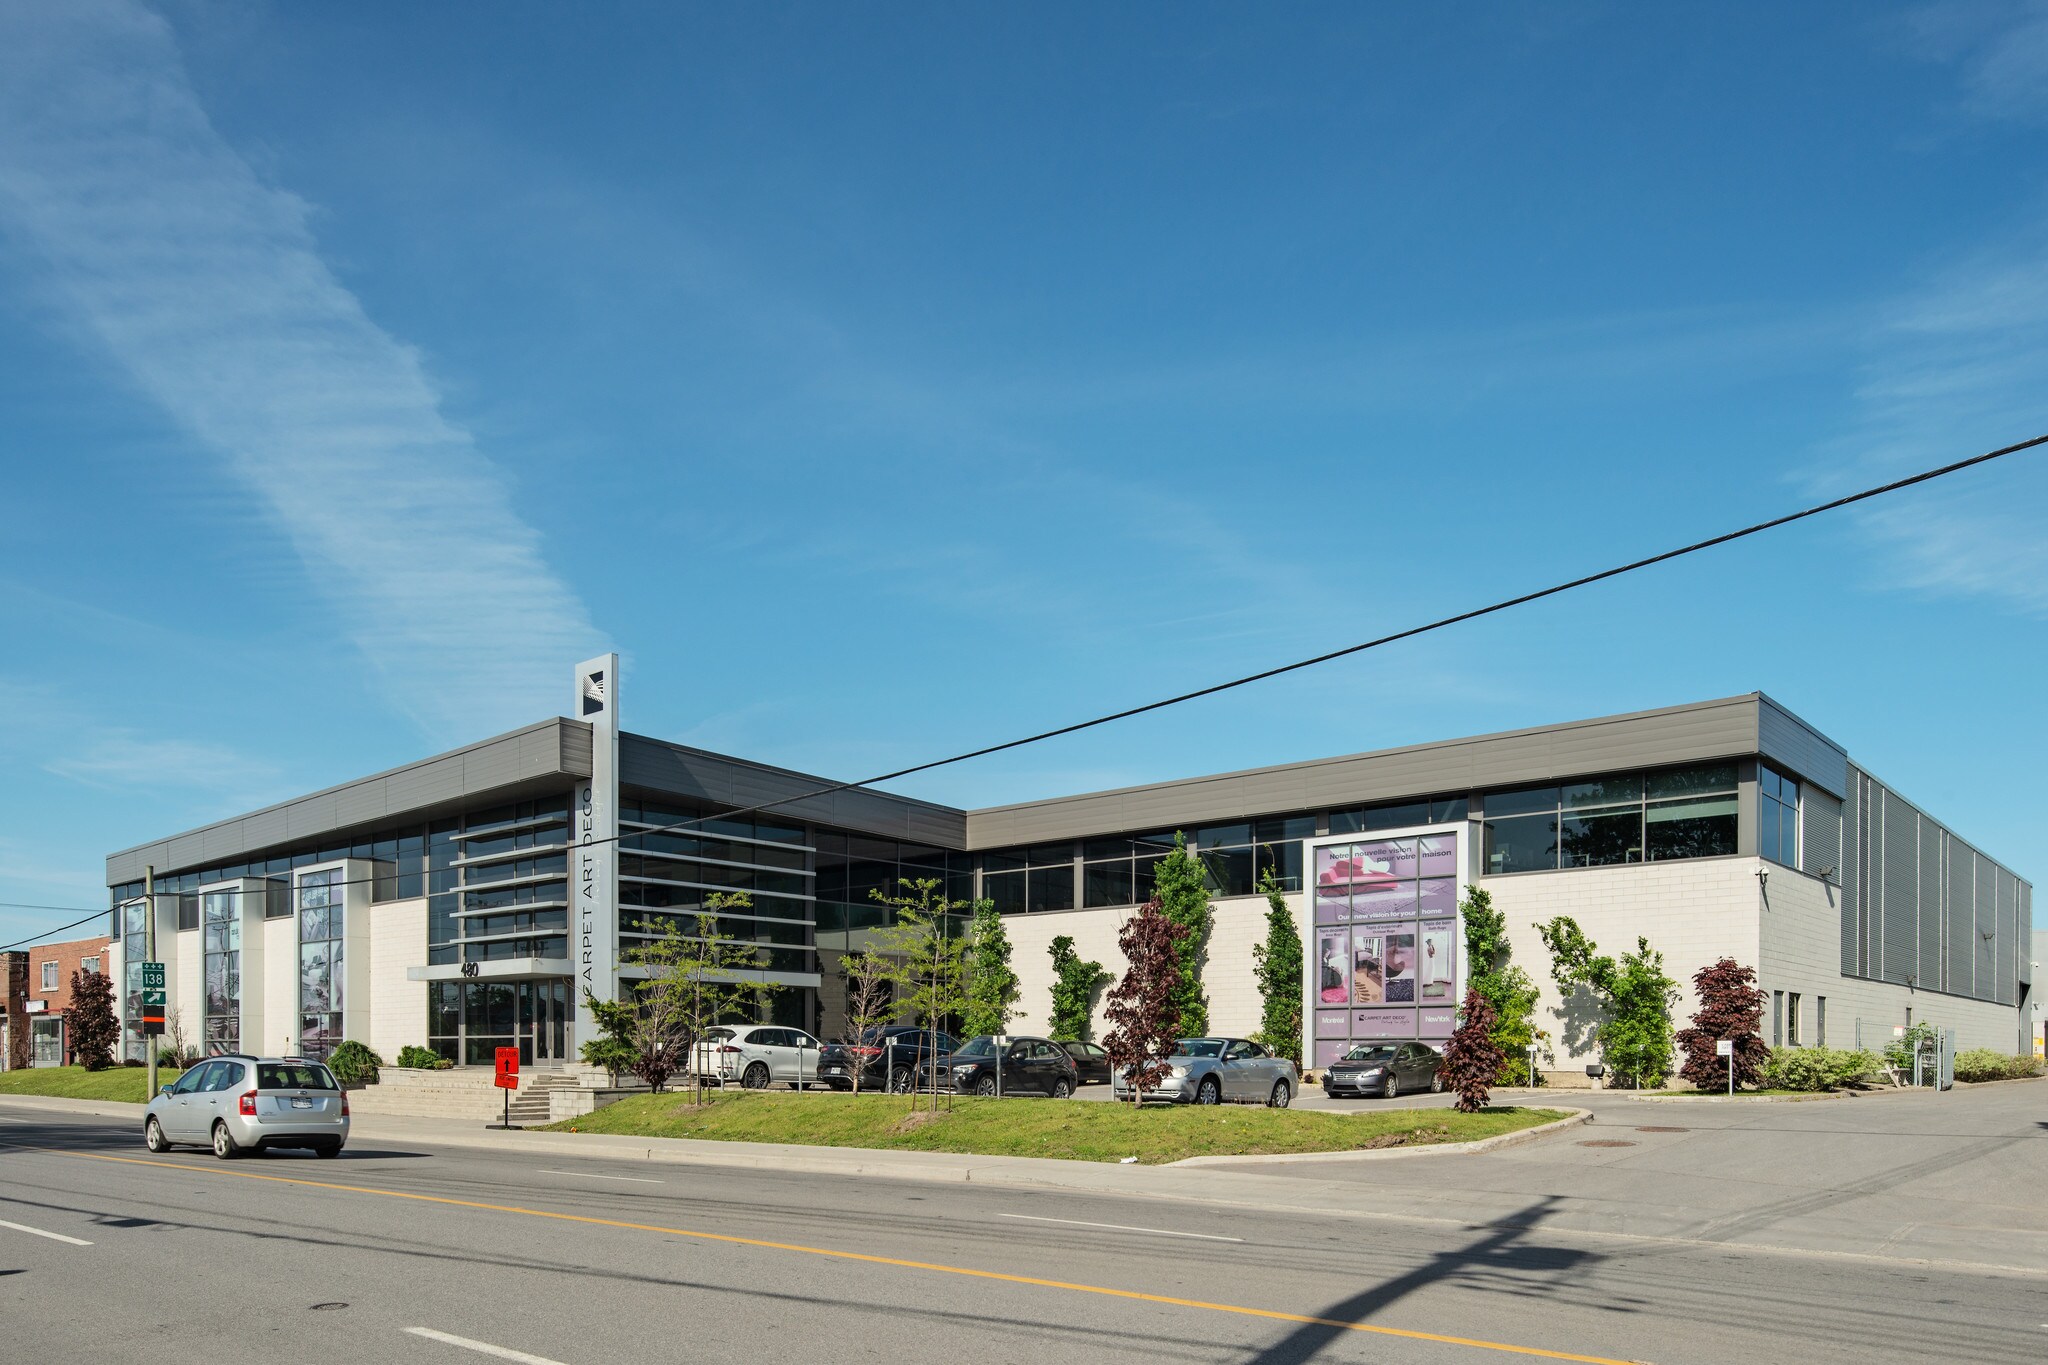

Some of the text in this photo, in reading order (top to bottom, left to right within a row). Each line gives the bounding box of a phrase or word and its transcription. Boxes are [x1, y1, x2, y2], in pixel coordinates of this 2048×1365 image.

[1329, 852, 1350, 860] Notre
[1354, 848, 1387, 857] nouvelle
[1396, 853, 1416, 861] votre
[1422, 850, 1452, 858] maison
[582, 787, 593, 997] CARPET ART DECO
[1400, 910, 1416, 918] your
[144, 973, 163, 984] 138
